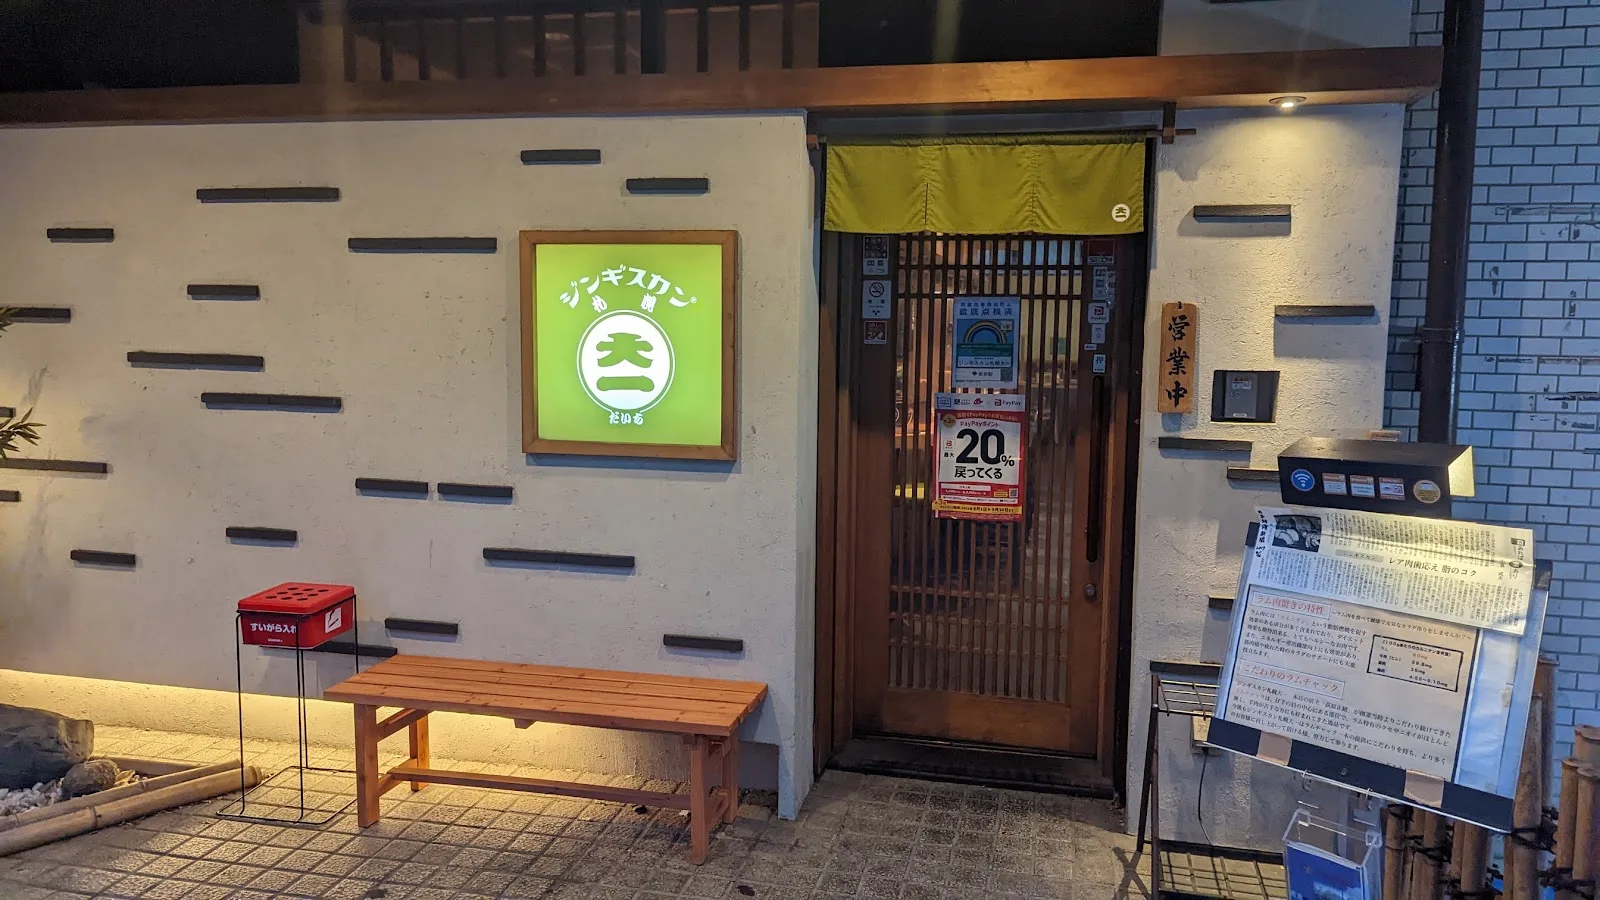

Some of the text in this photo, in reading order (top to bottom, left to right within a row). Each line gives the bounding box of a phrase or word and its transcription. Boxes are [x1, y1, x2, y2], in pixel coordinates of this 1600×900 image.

[559, 264, 692, 309] ジンギスカン
[1165, 314, 1191, 408] 営業中
[954, 466, 1003, 480] 戻ってくる
[1388, 557, 1477, 577] レア肉歯応え 脂のコク
[1244, 664, 1338, 692] こだわりのラムチャック
